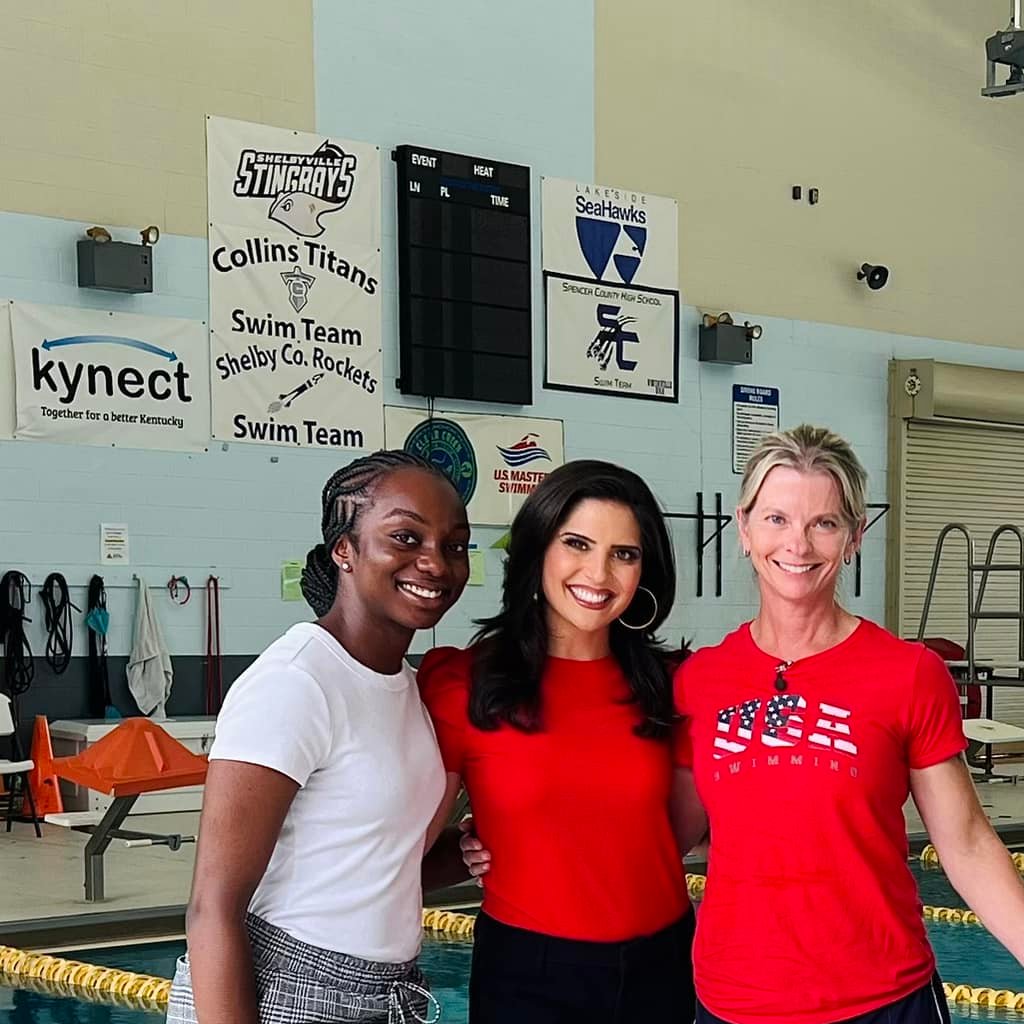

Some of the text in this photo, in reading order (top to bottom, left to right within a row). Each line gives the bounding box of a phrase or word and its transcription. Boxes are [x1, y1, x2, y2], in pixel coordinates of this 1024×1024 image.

[256, 153, 342, 166] SHELBYVILLE
[411, 153, 437, 168] EVENT
[473, 164, 494, 178] HEAT
[235, 151, 355, 198] STINGRAYS
[409, 181, 421, 193] LN
[440, 186, 451, 198] PL
[575, 184, 647, 205] LAKESIDE
[490, 194, 510, 208] TIME
[575, 196, 647, 224] SeaHawks
[212, 238, 378, 295] Collins Titans
[562, 282, 593, 296] SPENCER
[594, 287, 620, 300] COUNTY
[637, 294, 662, 306] SCHOOL
[231, 309, 362, 346] Swim Team
[31, 347, 193, 404] kynect
[215, 343, 378, 394] Shelby Co. Rockets
[41, 406, 184, 429] Together for a better Kentucky
[233, 414, 364, 448] Swim Team
[511, 470, 545, 483] MASTE
[498, 482, 537, 495] SWIMM
[713, 694, 858, 759] USA
